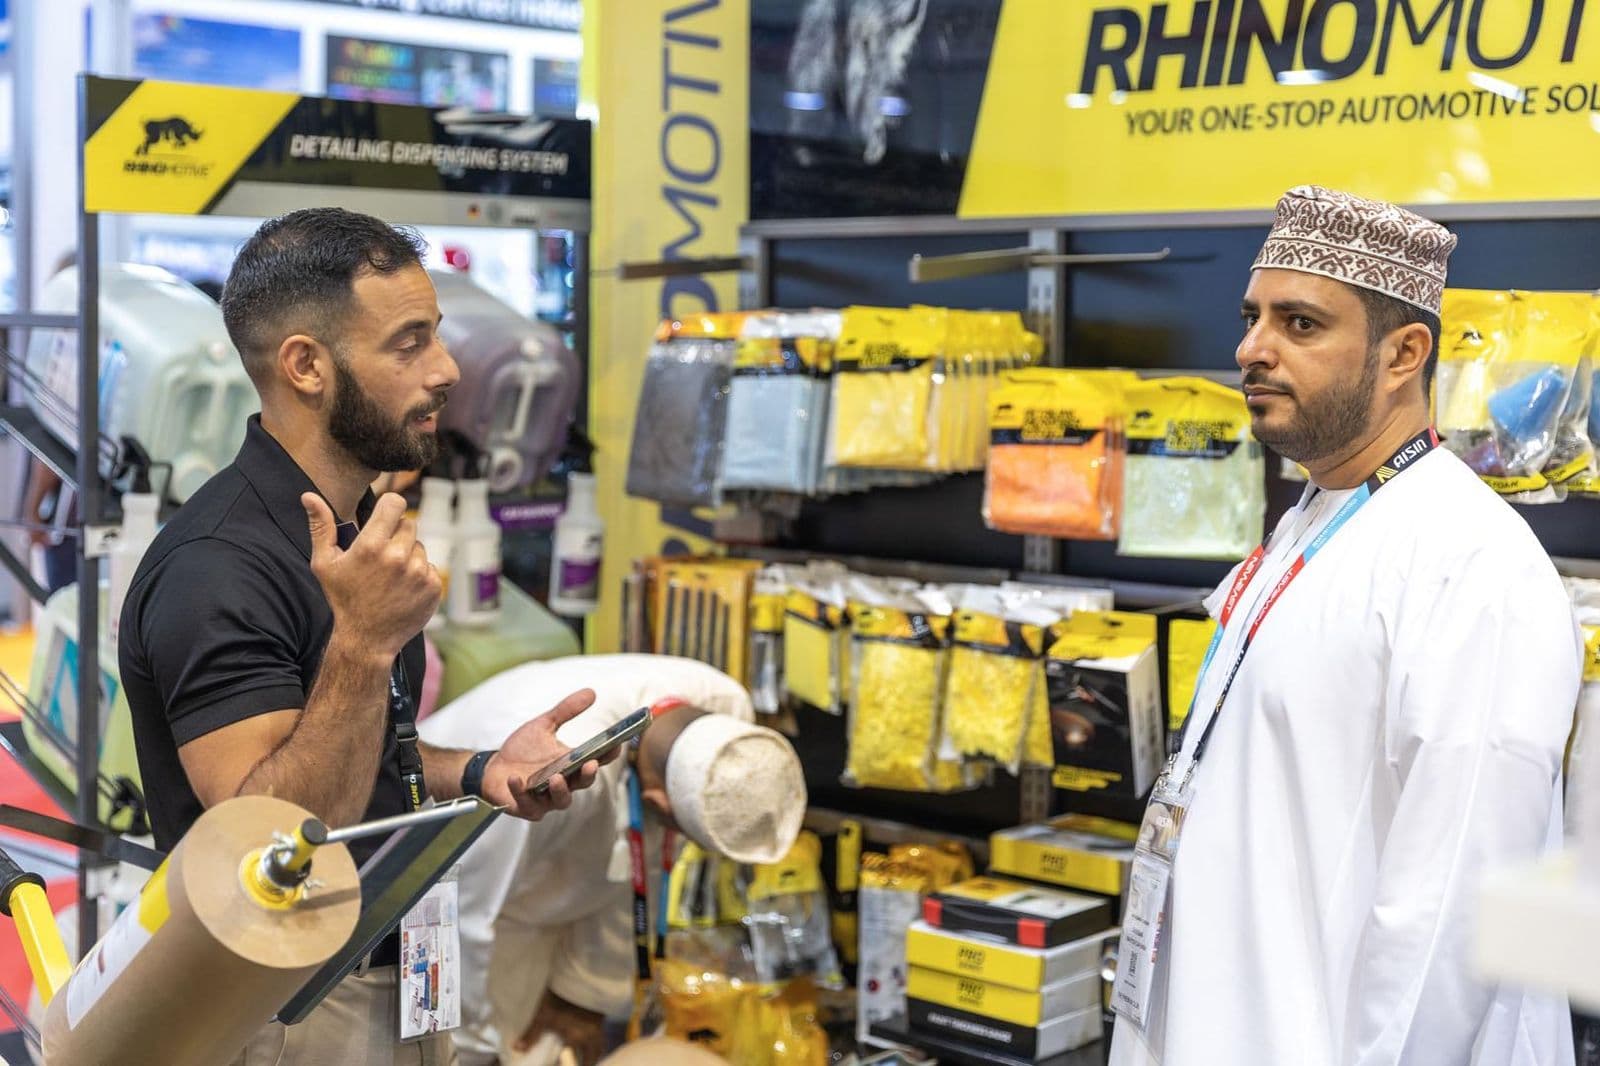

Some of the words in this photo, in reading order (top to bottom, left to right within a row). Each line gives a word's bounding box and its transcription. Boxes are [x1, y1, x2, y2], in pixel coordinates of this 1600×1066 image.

[1125, 107, 1194, 136] YOUR
[1201, 98, 1334, 132] ONE-STOP
[1338, 87, 1540, 123] AUTOMOTIVE
[290, 134, 390, 163] DETAILING
[392, 141, 497, 171] DISPENSING
[499, 148, 569, 175] SYSTEM
